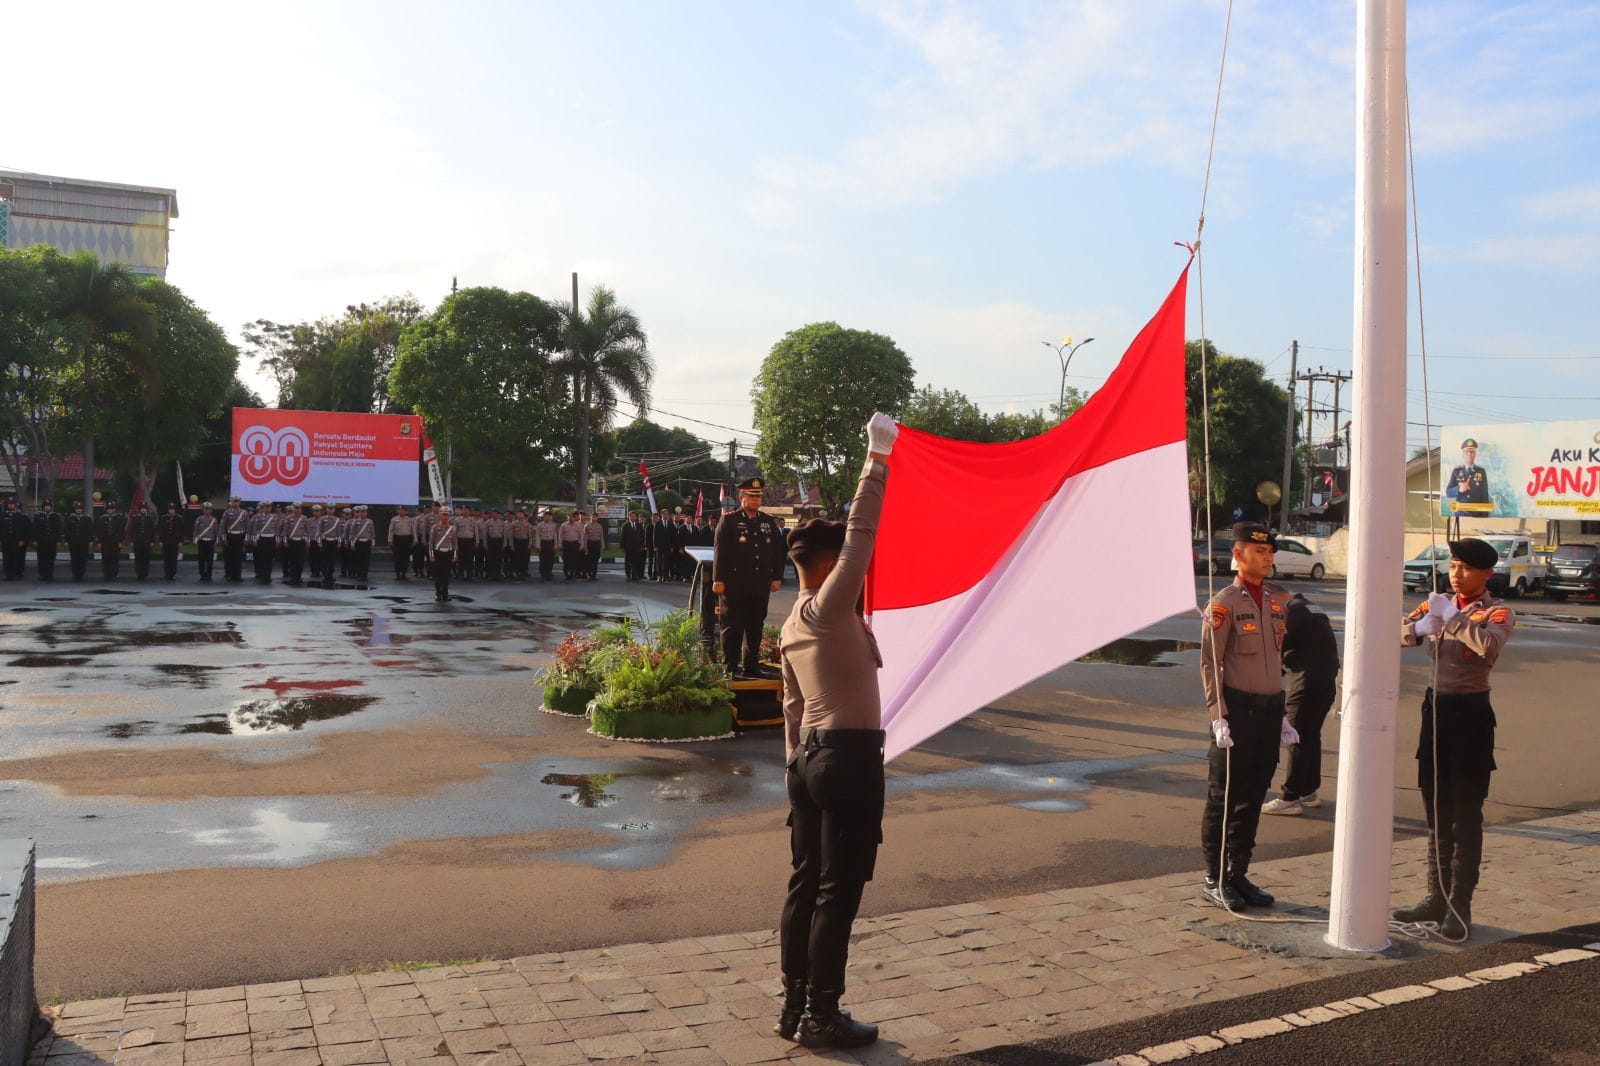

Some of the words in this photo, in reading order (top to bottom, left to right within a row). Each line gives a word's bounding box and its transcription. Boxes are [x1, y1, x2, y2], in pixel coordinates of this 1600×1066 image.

[239, 425, 310, 486] 80
[313, 449, 348, 457] Indonesia
[348, 450, 365, 458] Maju
[1550, 448, 1582, 463] AKU
[1526, 466, 1600, 497] JANJ
